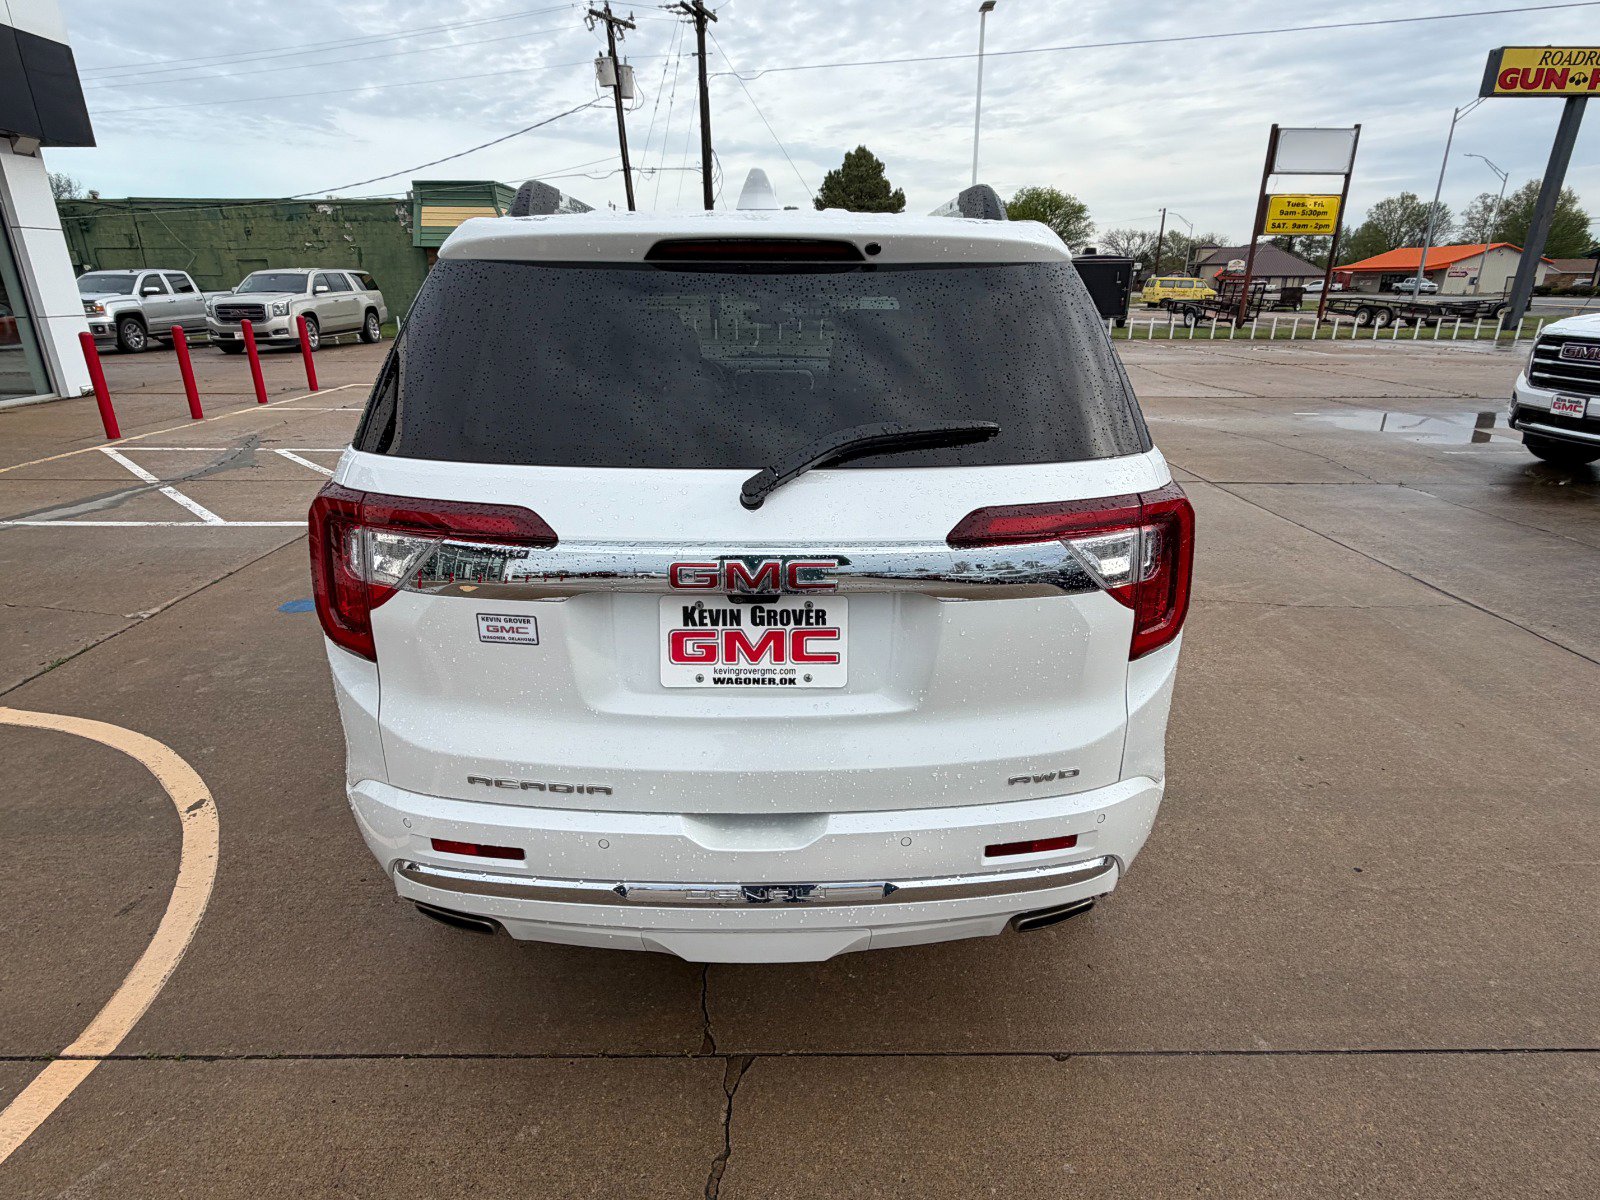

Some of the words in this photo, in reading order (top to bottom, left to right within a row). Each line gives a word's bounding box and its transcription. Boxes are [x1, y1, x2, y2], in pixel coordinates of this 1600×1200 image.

[1498, 67, 1570, 90] GUN
[1301, 209, 1328, 217] 5:30pm
[1313, 222, 1330, 230] 2pm
[1553, 401, 1583, 413] GMC
[669, 559, 839, 593] GMC
[682, 605, 742, 627] KEVIN
[750, 605, 827, 627] GROVER
[486, 625, 529, 634] GMC
[668, 627, 841, 666] GMC
[713, 666, 797, 677] kevingrovergmc.com
[1007, 767, 1080, 786] AWD
[467, 774, 613, 796] ACADIA
[686, 886, 827, 900] DENALI
